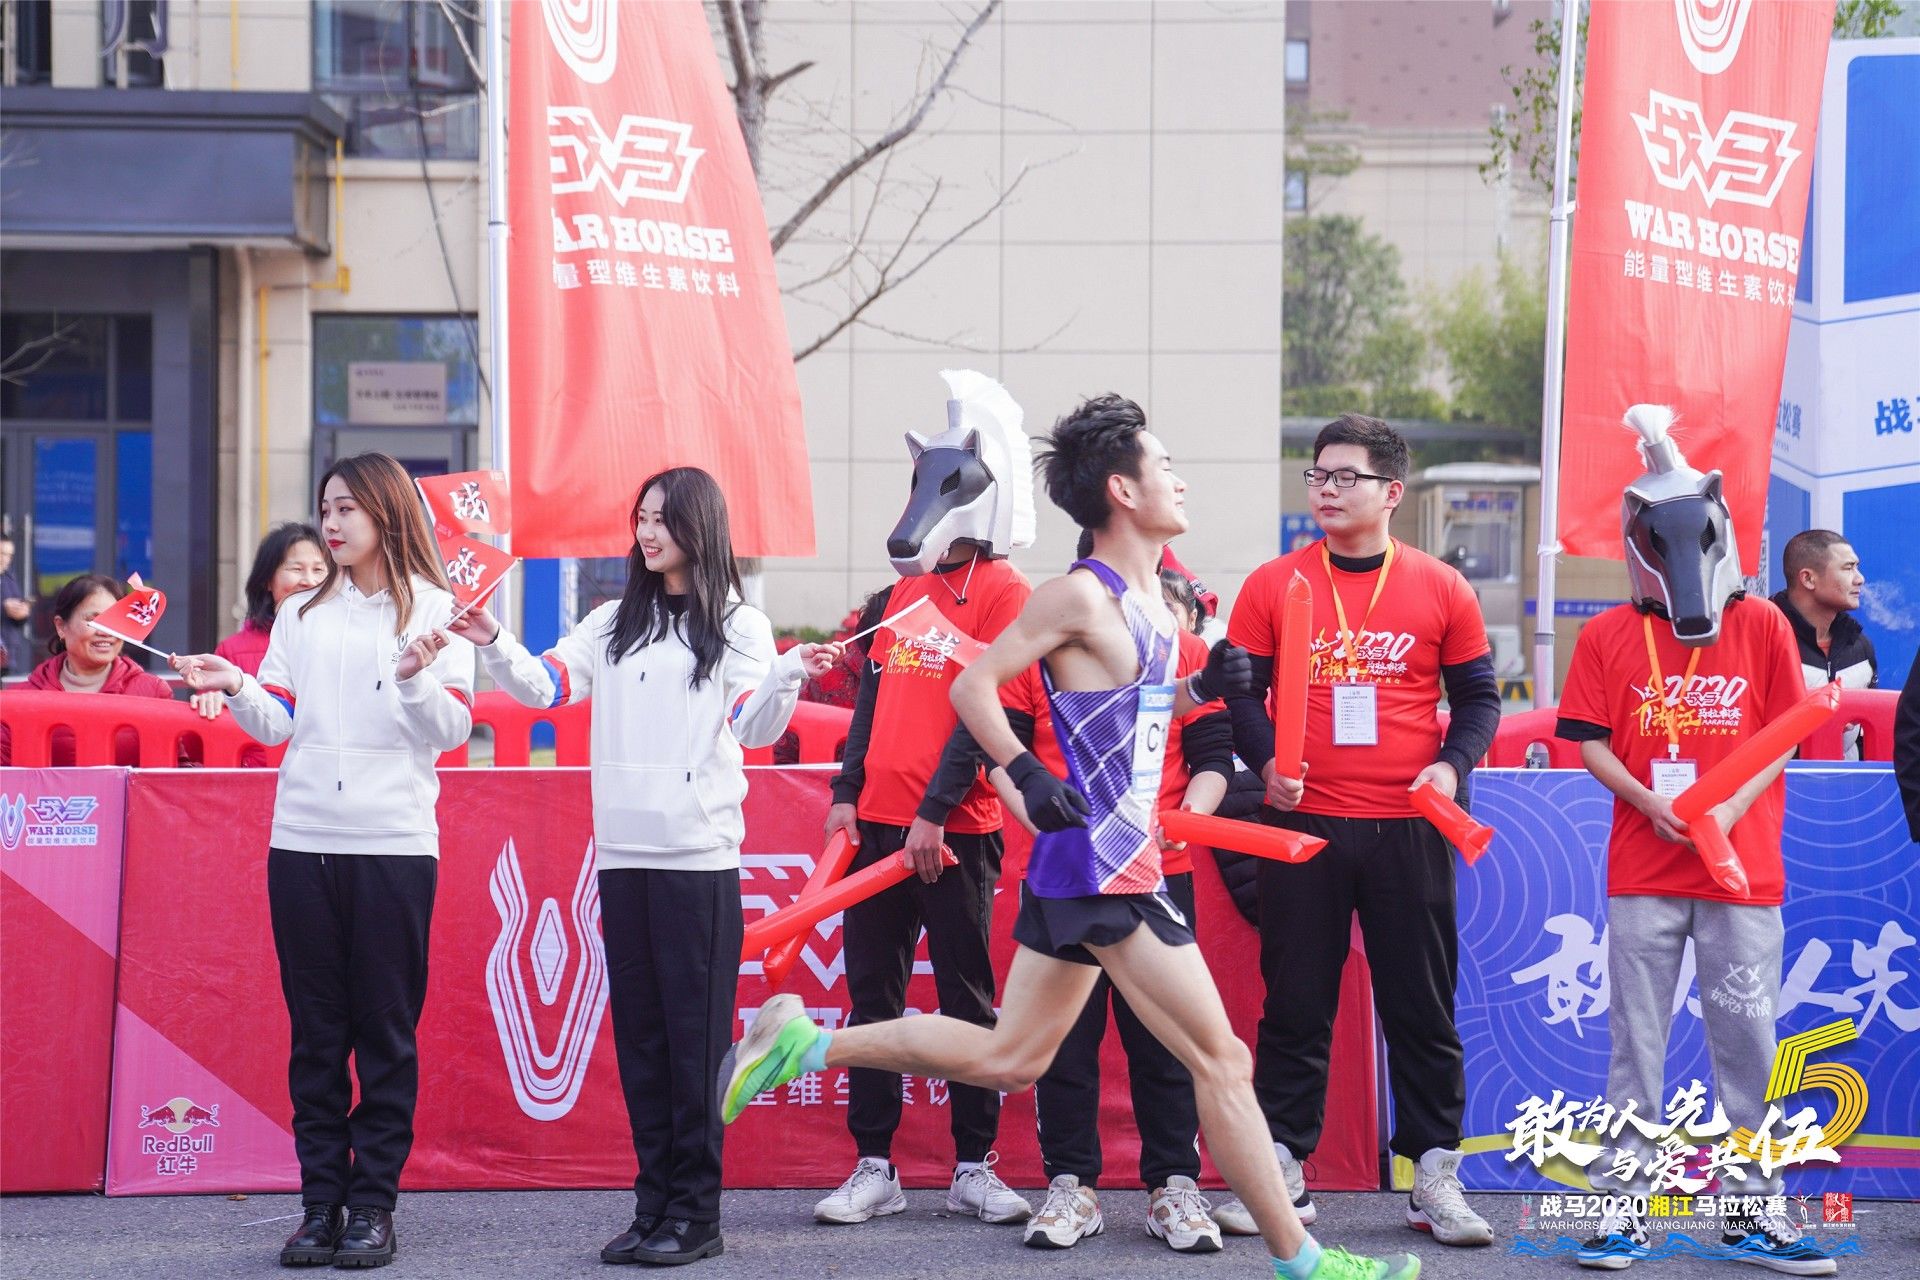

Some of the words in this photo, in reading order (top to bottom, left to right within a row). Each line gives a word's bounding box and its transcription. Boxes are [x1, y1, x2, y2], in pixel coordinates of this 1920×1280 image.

[609, 215, 735, 263] HORSE
[1624, 199, 1694, 251] WAR
[1697, 217, 1799, 275] HORSE
[1664, 674, 1748, 707] 2020
[27, 825, 54, 836] WAR
[55, 825, 97, 836] HORSE
[143, 1134, 213, 1153] RedBull
[158, 1155, 197, 1174] 红牛
